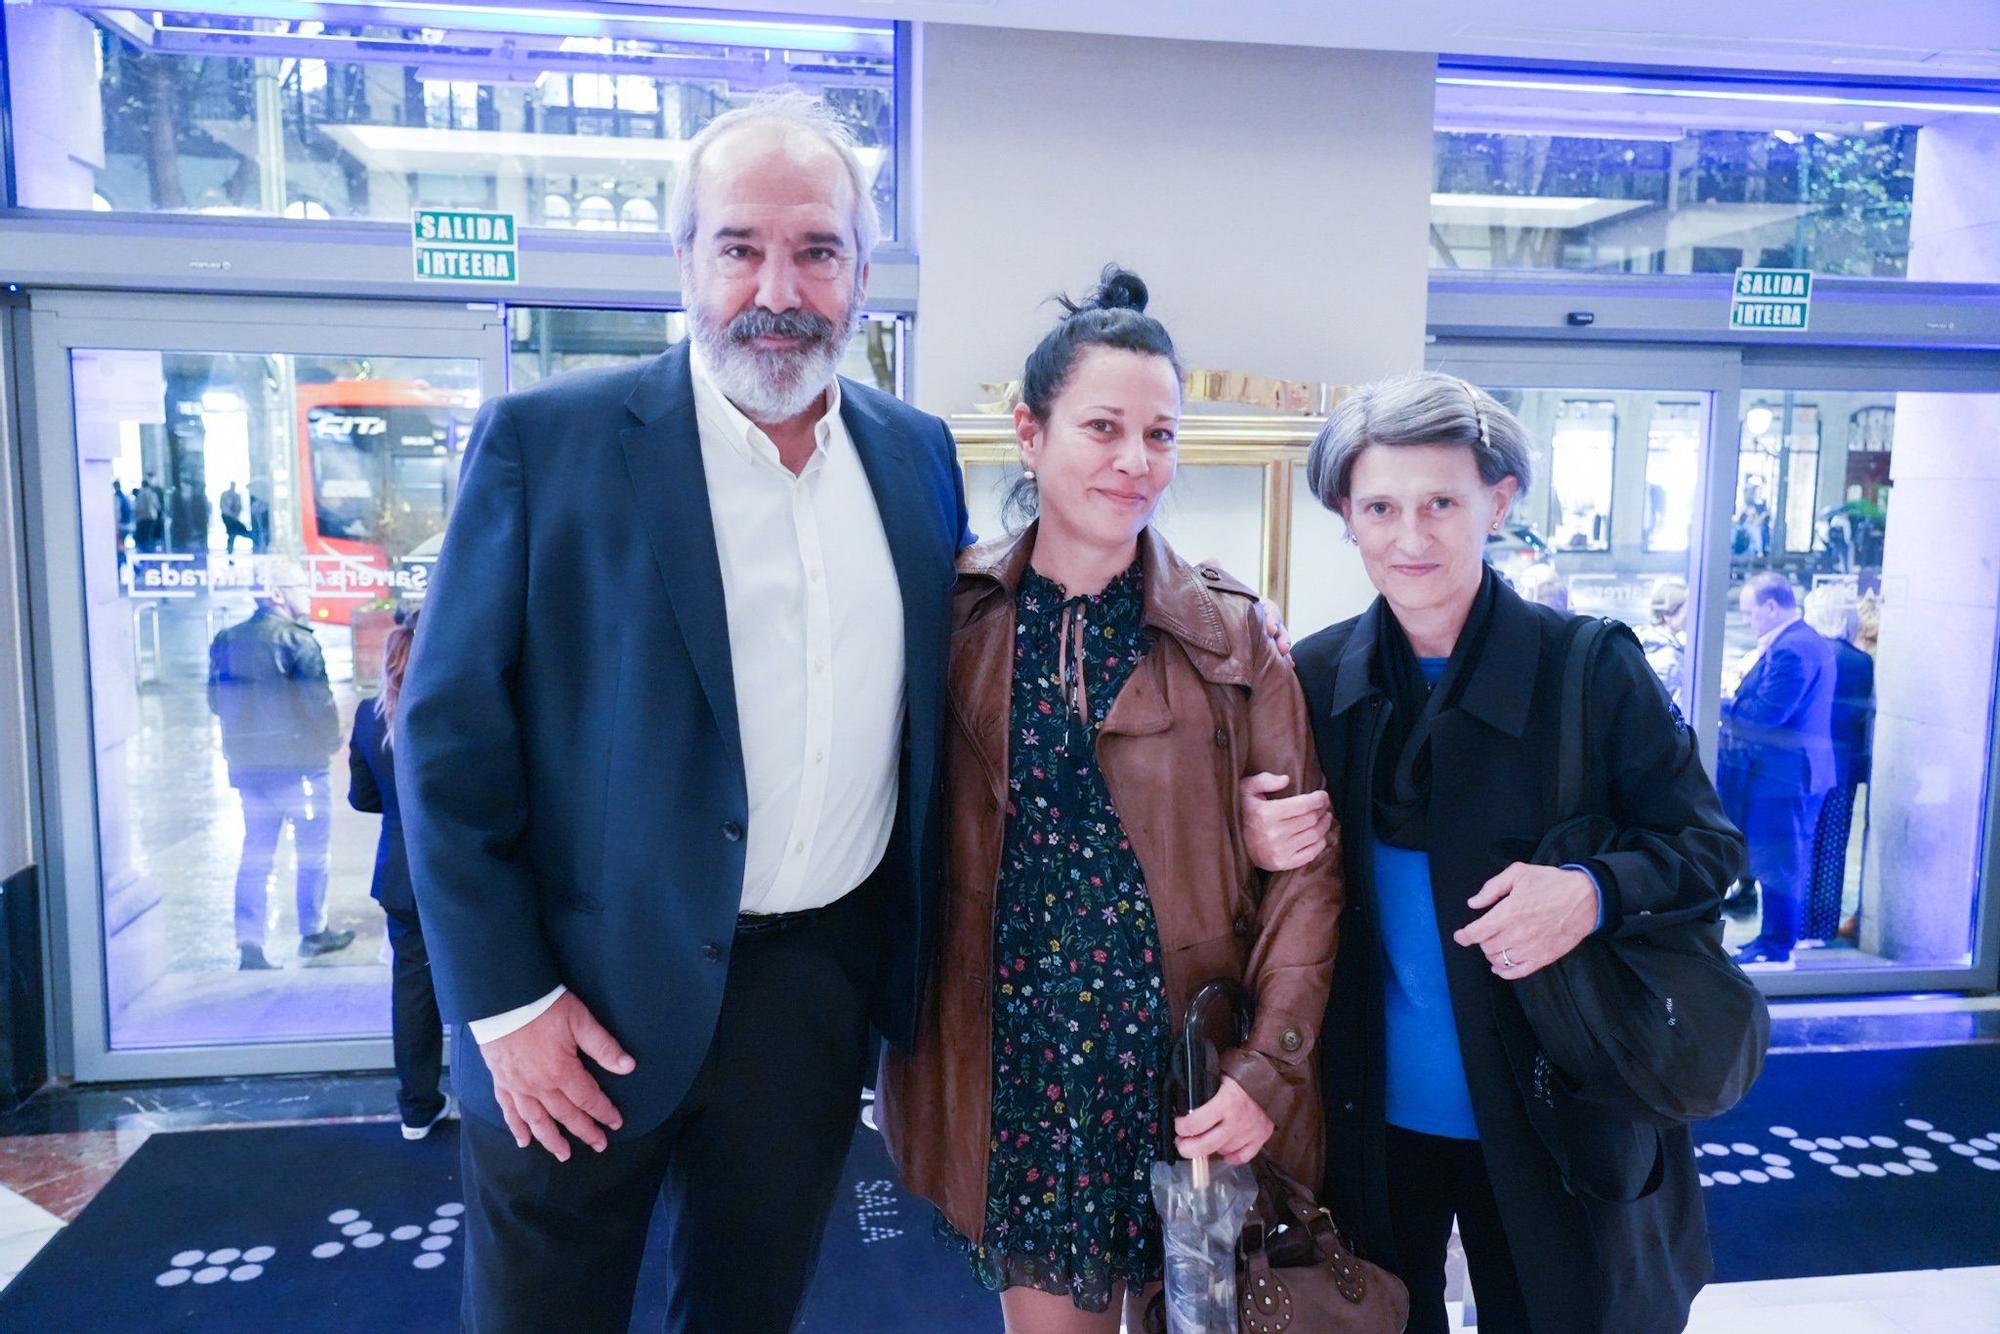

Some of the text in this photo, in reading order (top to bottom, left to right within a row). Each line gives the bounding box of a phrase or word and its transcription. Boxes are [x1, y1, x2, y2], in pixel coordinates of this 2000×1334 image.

[421, 215, 508, 241] SALIDA
[423, 251, 510, 277] IRTEERA
[1741, 273, 1804, 295] SALIDA
[1737, 304, 1801, 325] IRTEERA
[855, 1180, 904, 1243] SALA
